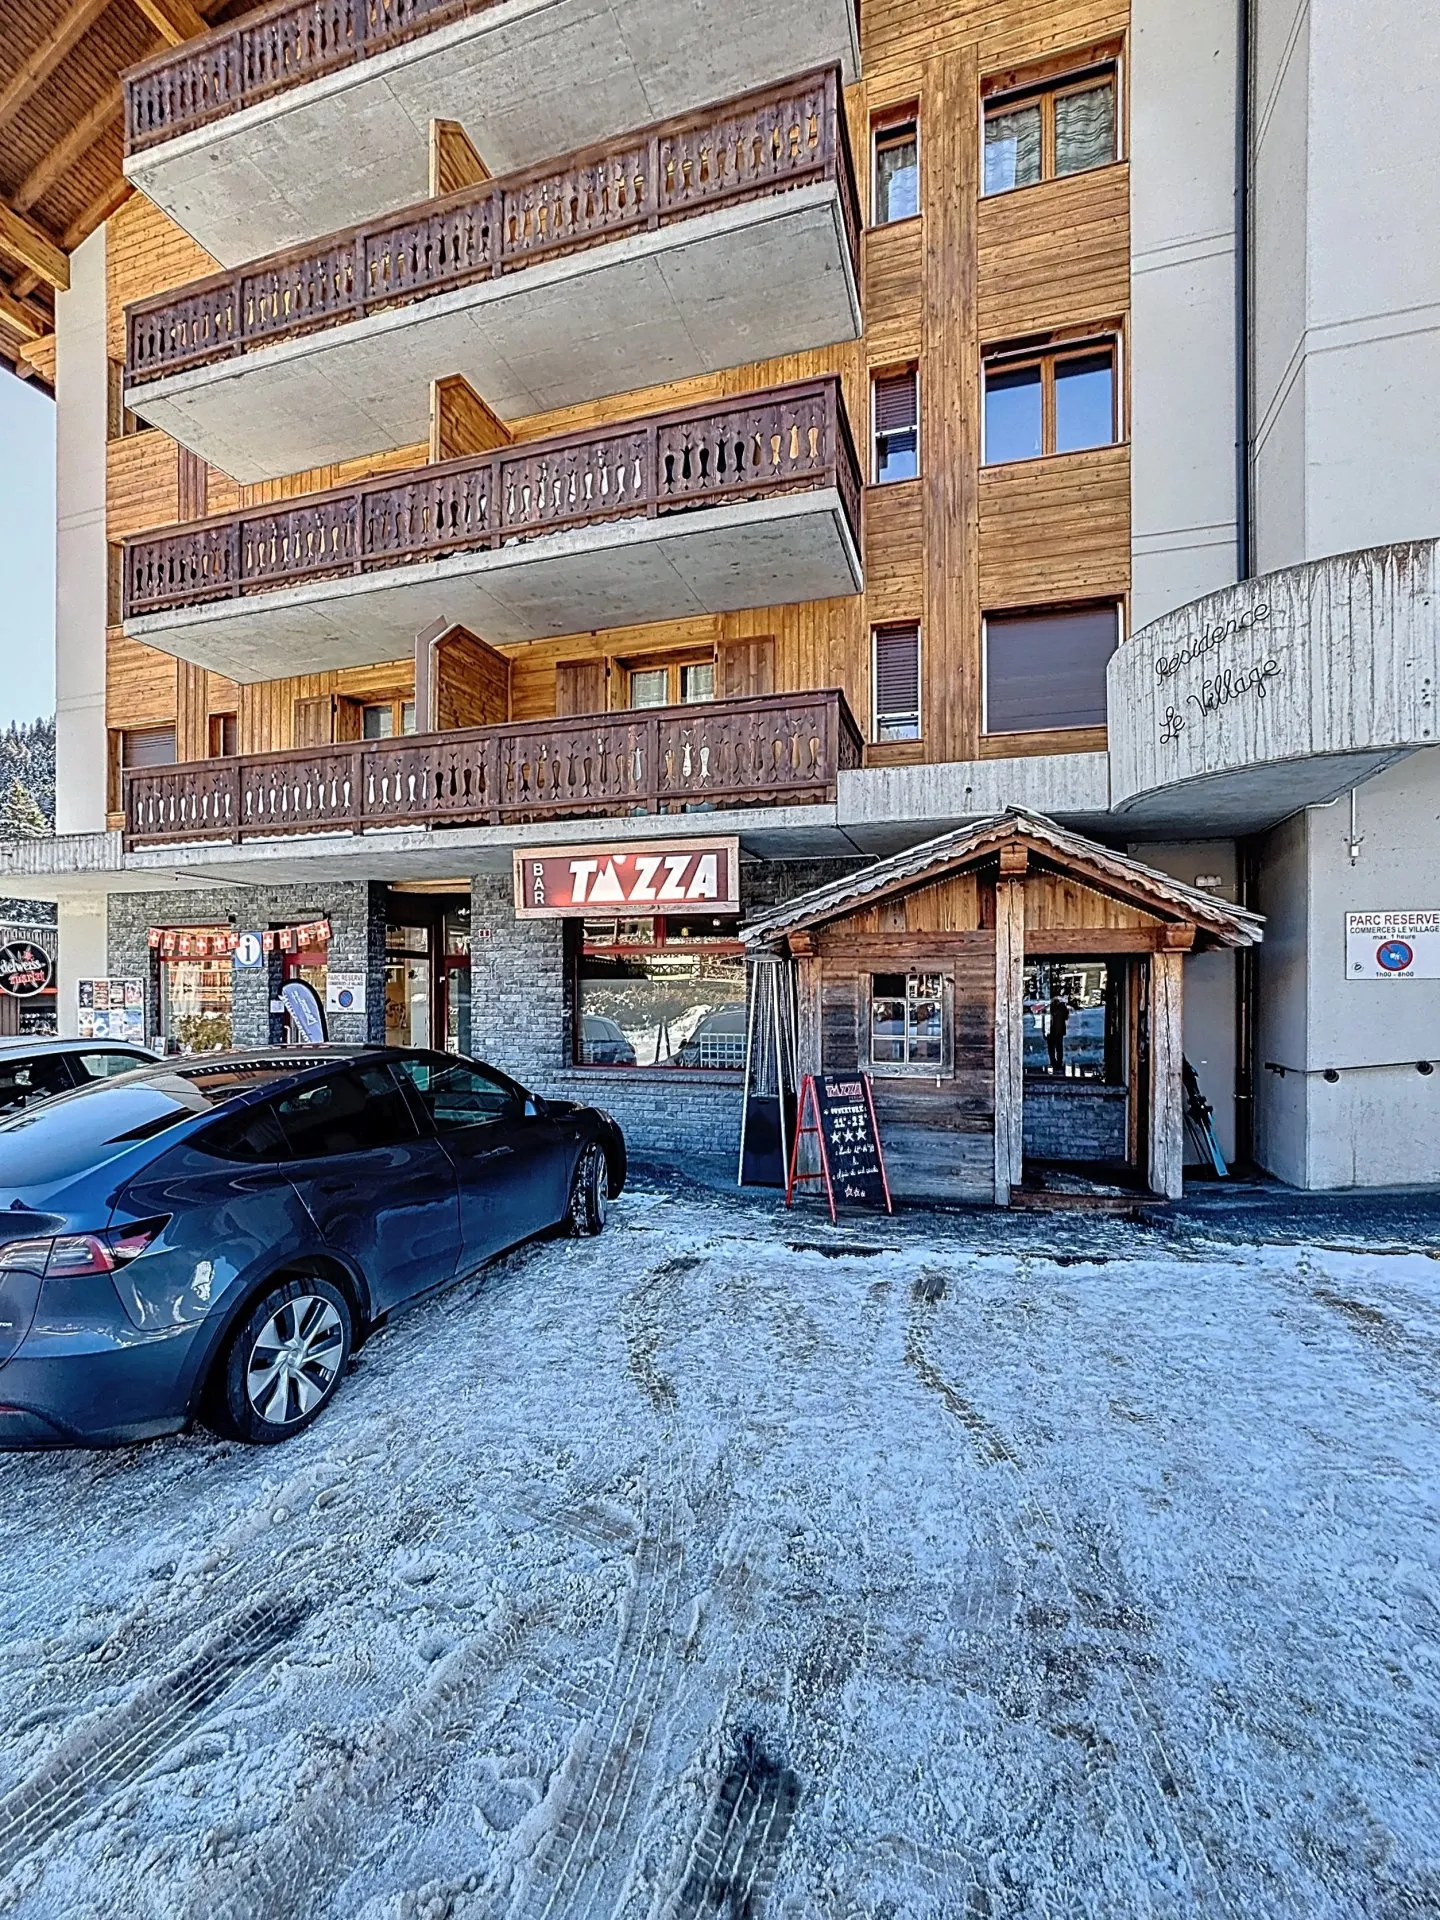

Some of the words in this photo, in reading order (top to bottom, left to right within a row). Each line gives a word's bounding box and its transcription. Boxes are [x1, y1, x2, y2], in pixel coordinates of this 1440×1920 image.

[1159, 706, 1186, 744] Le
[1186, 660, 1281, 717] Village
[533, 862, 545, 904] BAR
[569, 854, 718, 903] TAZZA
[1350, 915, 1381, 926] PARC
[1350, 926, 1396, 934] COMMERCES
[1409, 925, 1440, 933] VILLAGE
[825, 1083, 862, 1097] TAZZA
